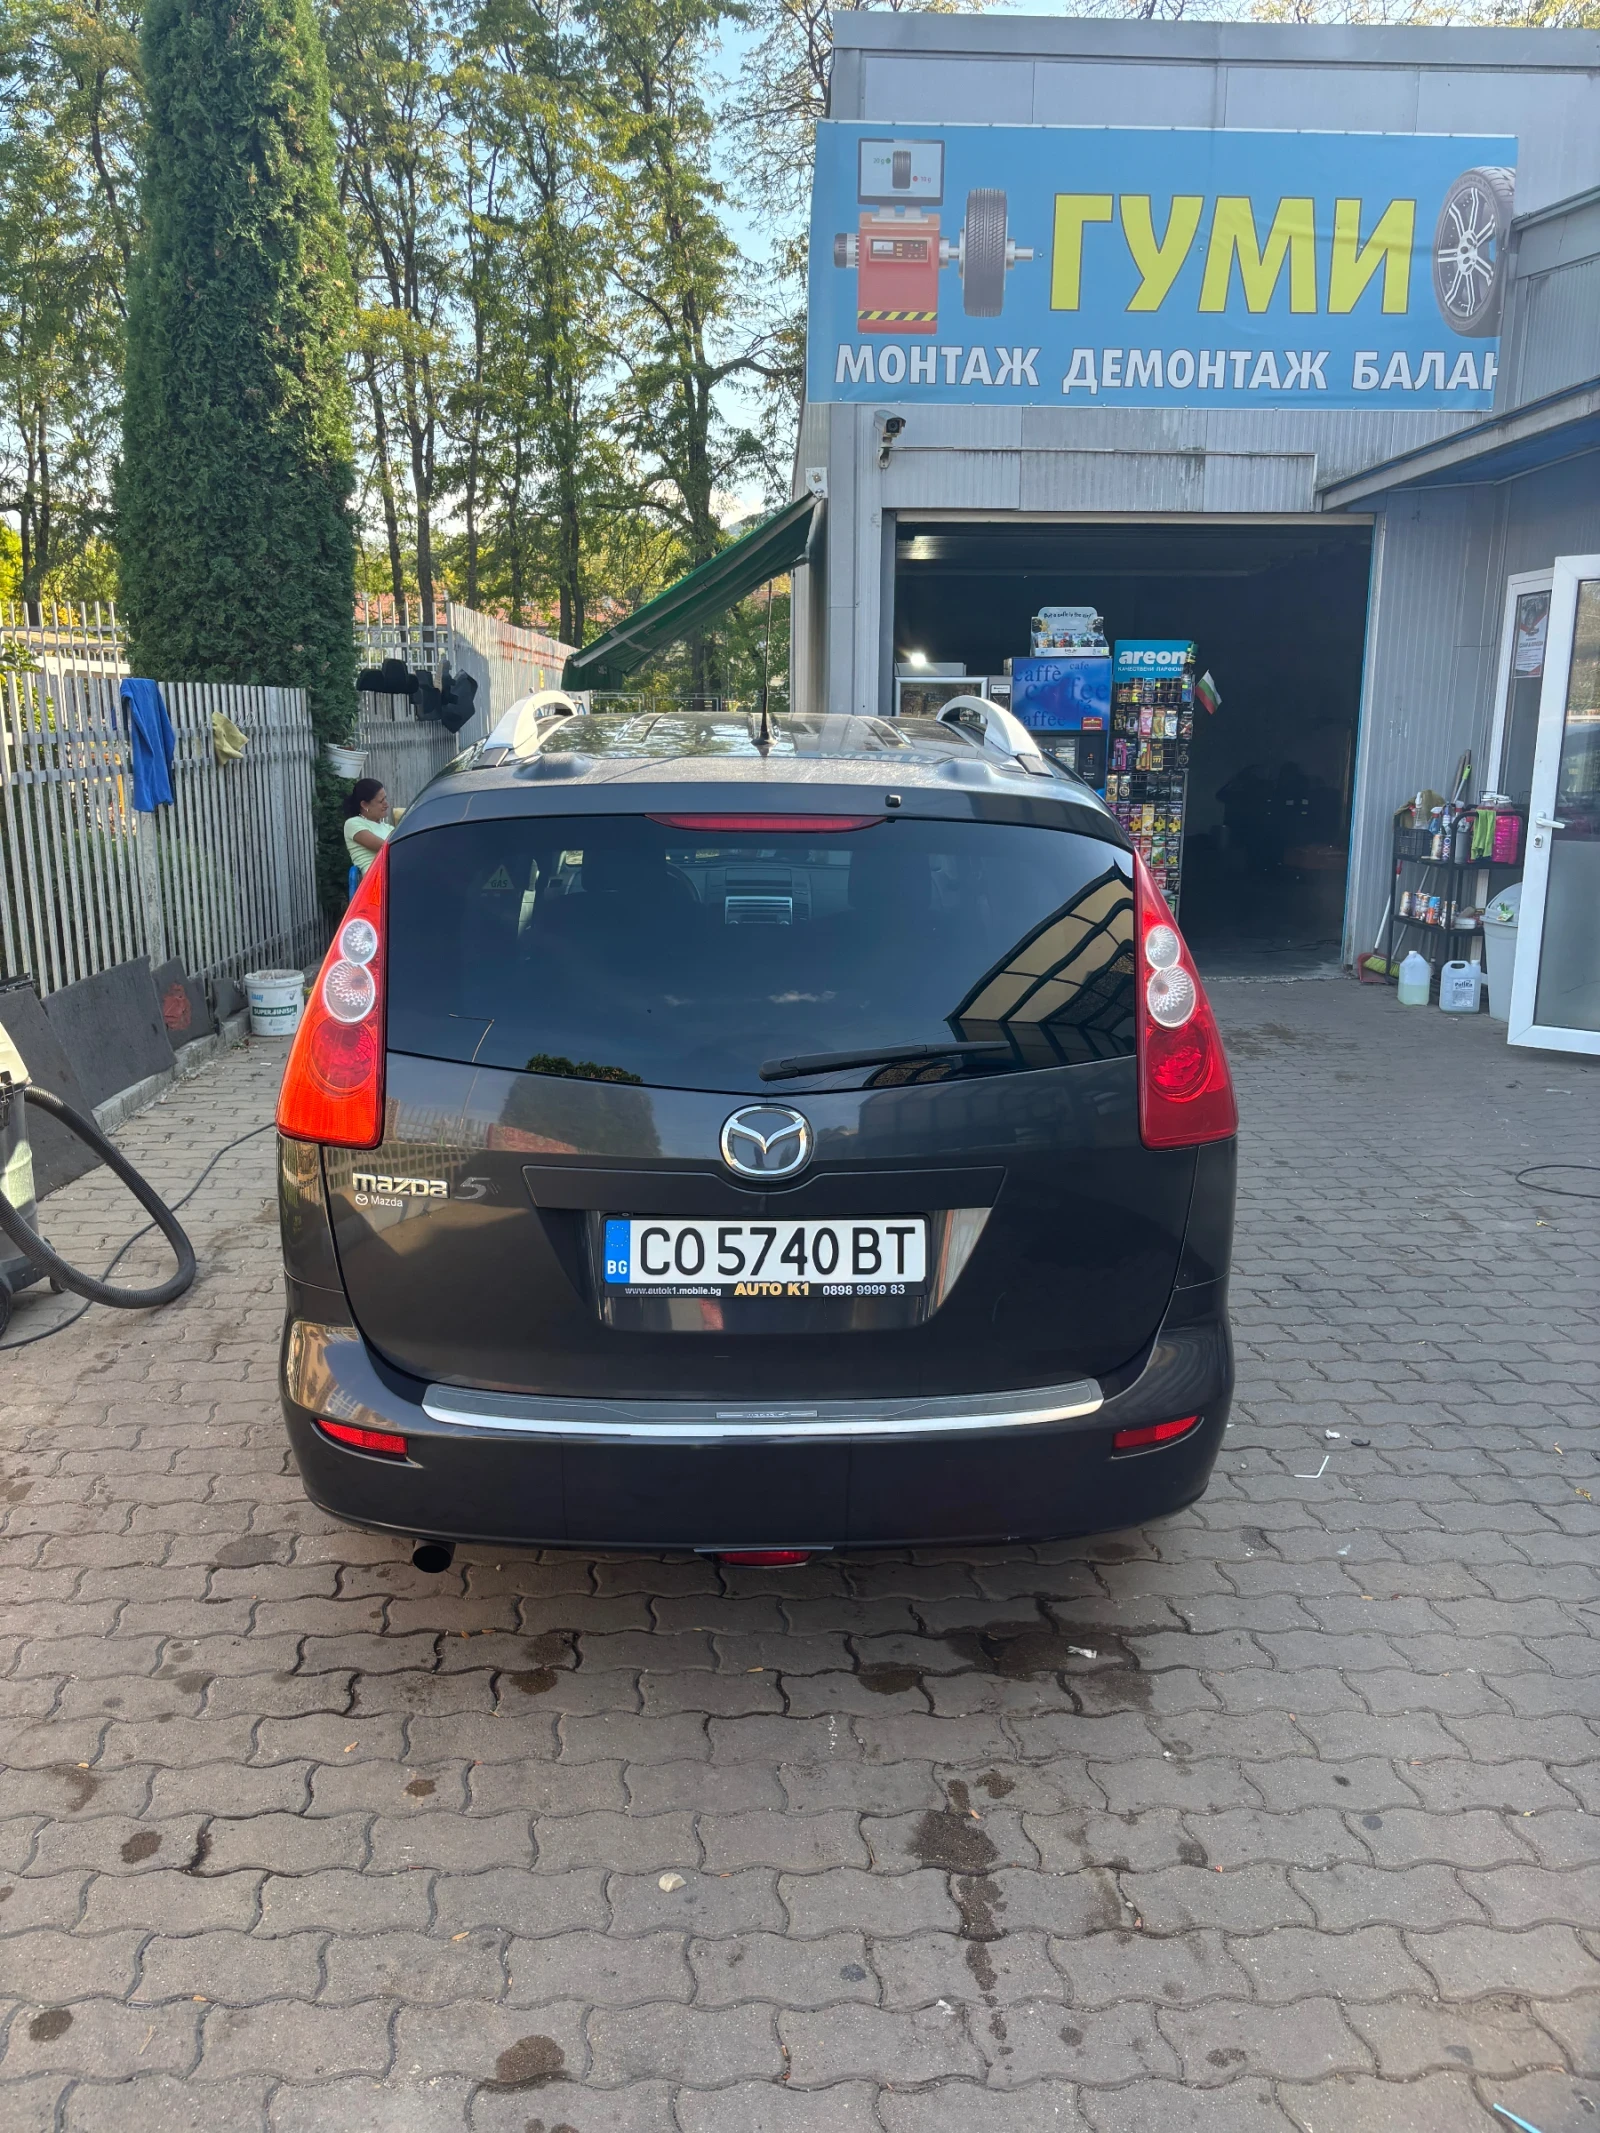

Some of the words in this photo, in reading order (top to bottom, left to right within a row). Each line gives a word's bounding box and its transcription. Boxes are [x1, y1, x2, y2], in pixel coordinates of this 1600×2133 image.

[1049, 192, 1417, 315] ГУМИ
[834, 343, 1042, 387] МОНТАЖ
[1061, 347, 1331, 395] ДЕМОНТАЖ
[1118, 651, 1187, 664] areon
[1022, 710, 1066, 727] affee
[491, 879, 508, 888] GAS
[454, 1176, 491, 1200] 5
[370, 1195, 403, 1207] Mazda
[607, 1260, 628, 1275] BG
[640, 1226, 705, 1276] CO
[717, 1226, 840, 1276] 5740
[852, 1226, 916, 1275] BT
[624, 1286, 722, 1297] www.autok1.mobile.bg
[734, 1282, 782, 1296] AUTO
[787, 1282, 810, 1296] K1
[822, 1285, 853, 1296] 0898
[856, 1284, 887, 1295] 9999
[890, 1284, 906, 1295] 83
